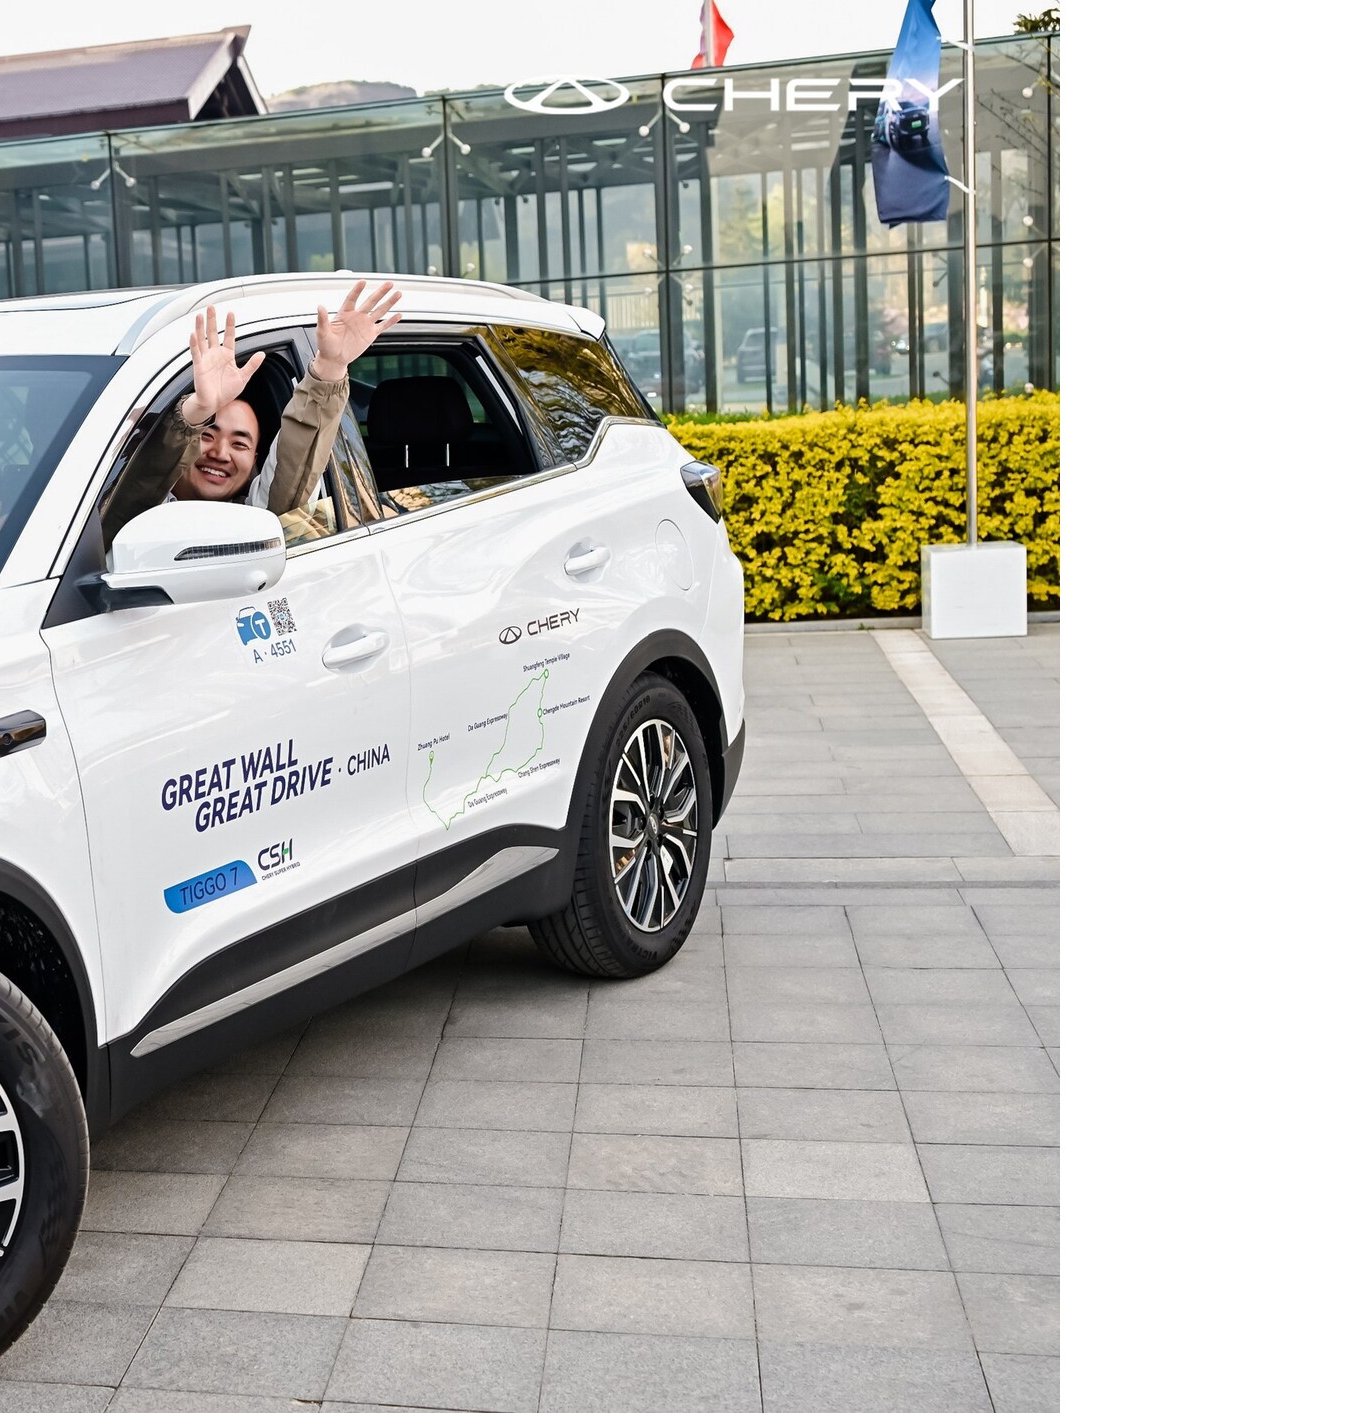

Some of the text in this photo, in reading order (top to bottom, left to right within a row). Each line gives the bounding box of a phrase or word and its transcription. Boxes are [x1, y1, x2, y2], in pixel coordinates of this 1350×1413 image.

[527, 608, 580, 636] CHERY
[558, 652, 570, 661] Village
[542, 695, 590, 716] Chengde Mountain Resort
[468, 713, 508, 732] Da Guang Expressway
[439, 732, 451, 742] Hotel
[161, 739, 299, 811] GREAT WALL
[195, 780, 268, 833] GREAT
[270, 757, 334, 806] DRIVE
[347, 743, 391, 776] CHINA
[474, 798, 488, 806] Guang
[258, 838, 293, 871] CSH
[261, 861, 301, 881] CHERY SUPER HYBRID
[180, 866, 238, 906] TIGGO 7
